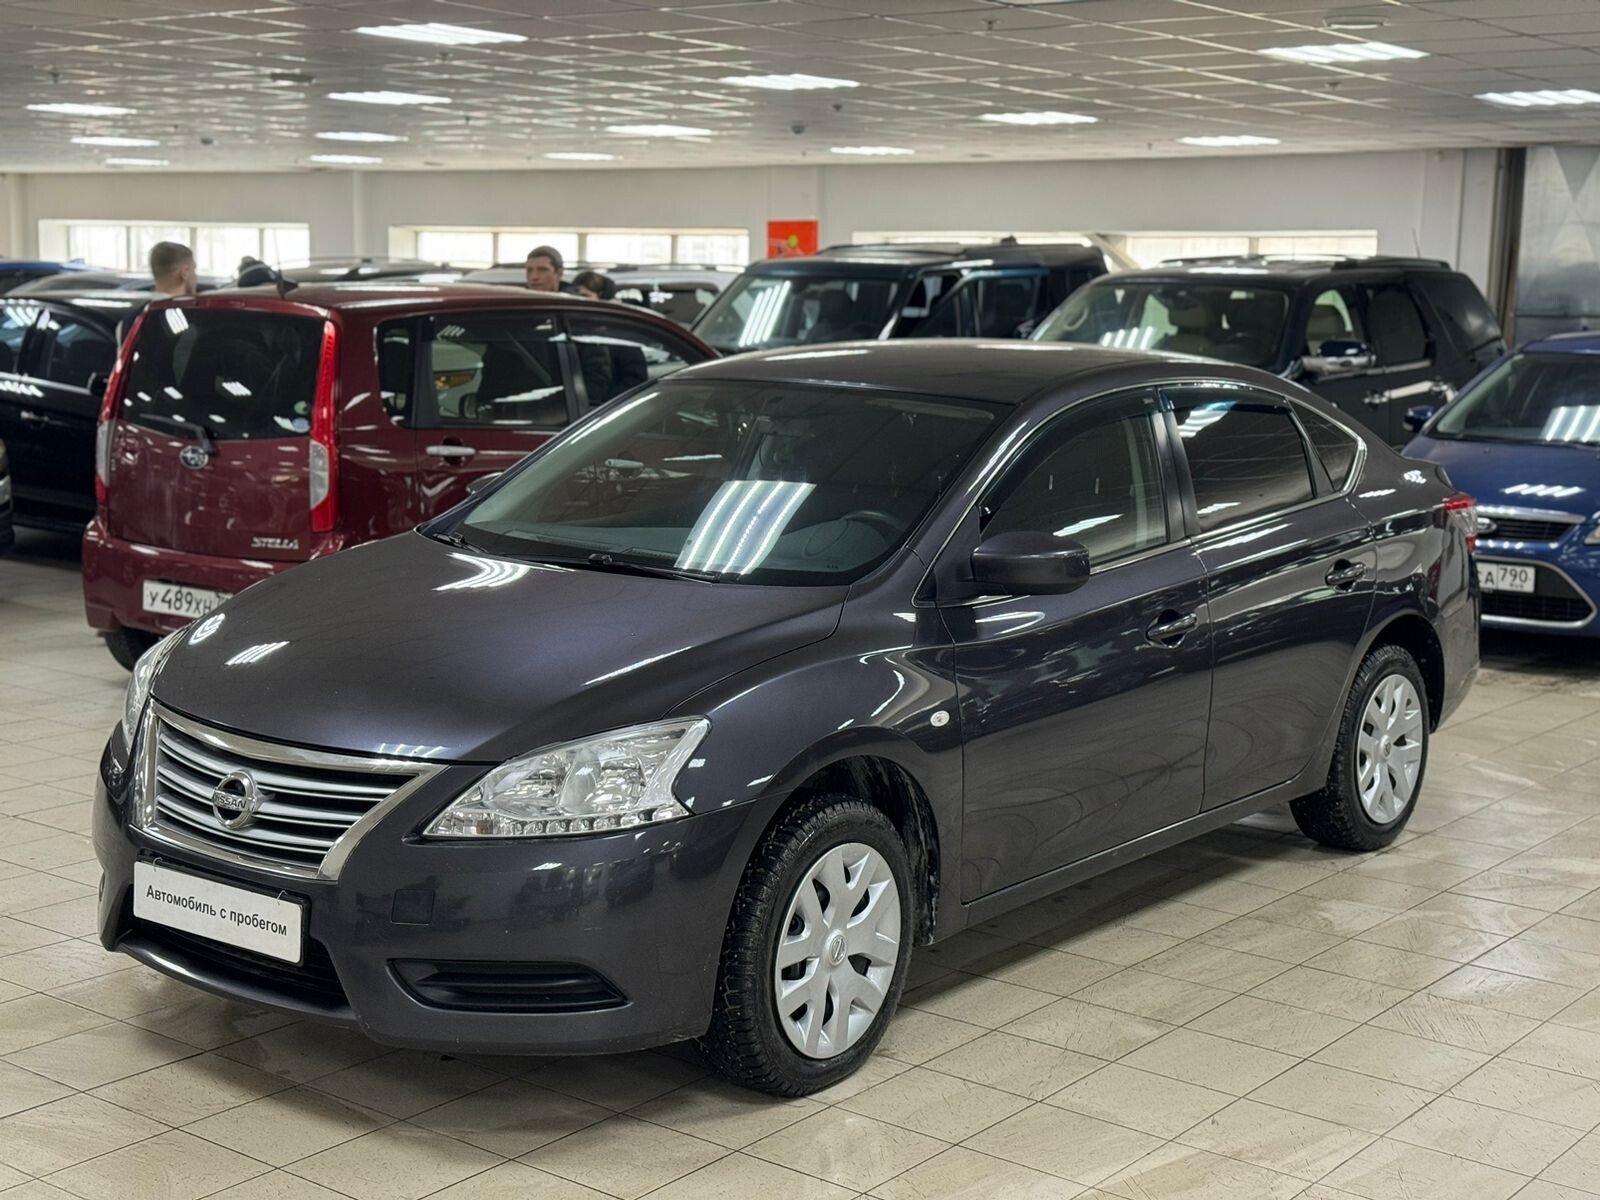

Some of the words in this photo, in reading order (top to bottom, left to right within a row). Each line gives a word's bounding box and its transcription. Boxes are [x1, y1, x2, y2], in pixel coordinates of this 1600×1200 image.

[251, 536, 299, 549] STELLA
[1499, 567, 1528, 583] 790
[146, 884, 217, 917] Автомобиль
[219, 907, 228, 919] с
[229, 911, 287, 936] пробегом
